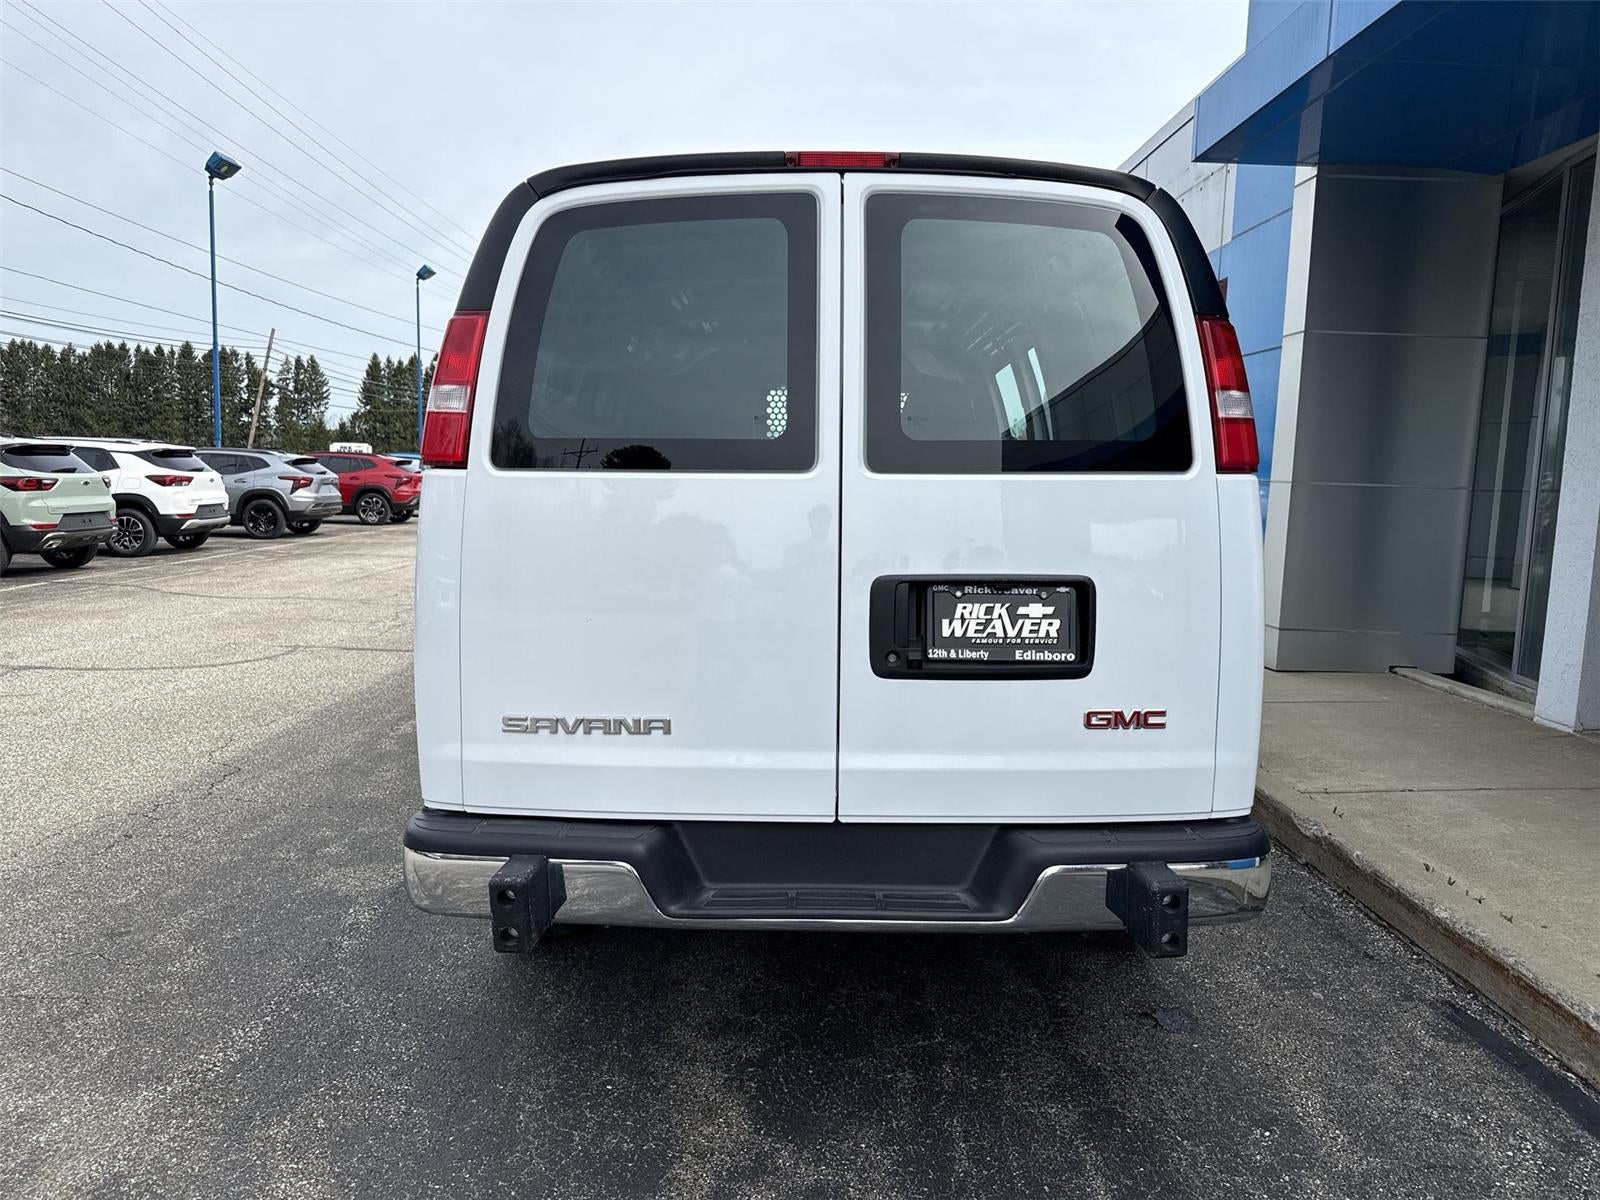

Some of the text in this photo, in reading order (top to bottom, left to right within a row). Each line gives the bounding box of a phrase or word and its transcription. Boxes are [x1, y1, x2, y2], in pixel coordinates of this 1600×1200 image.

[964, 586, 1038, 595] Rick aver
[954, 603, 1011, 619] RICK
[942, 618, 1061, 638] WEAVER
[928, 649, 989, 660] 12th & Liberty
[1015, 650, 1075, 661] Edinboro
[501, 715, 671, 735] SAVANA
[1083, 709, 1167, 730] GMC
